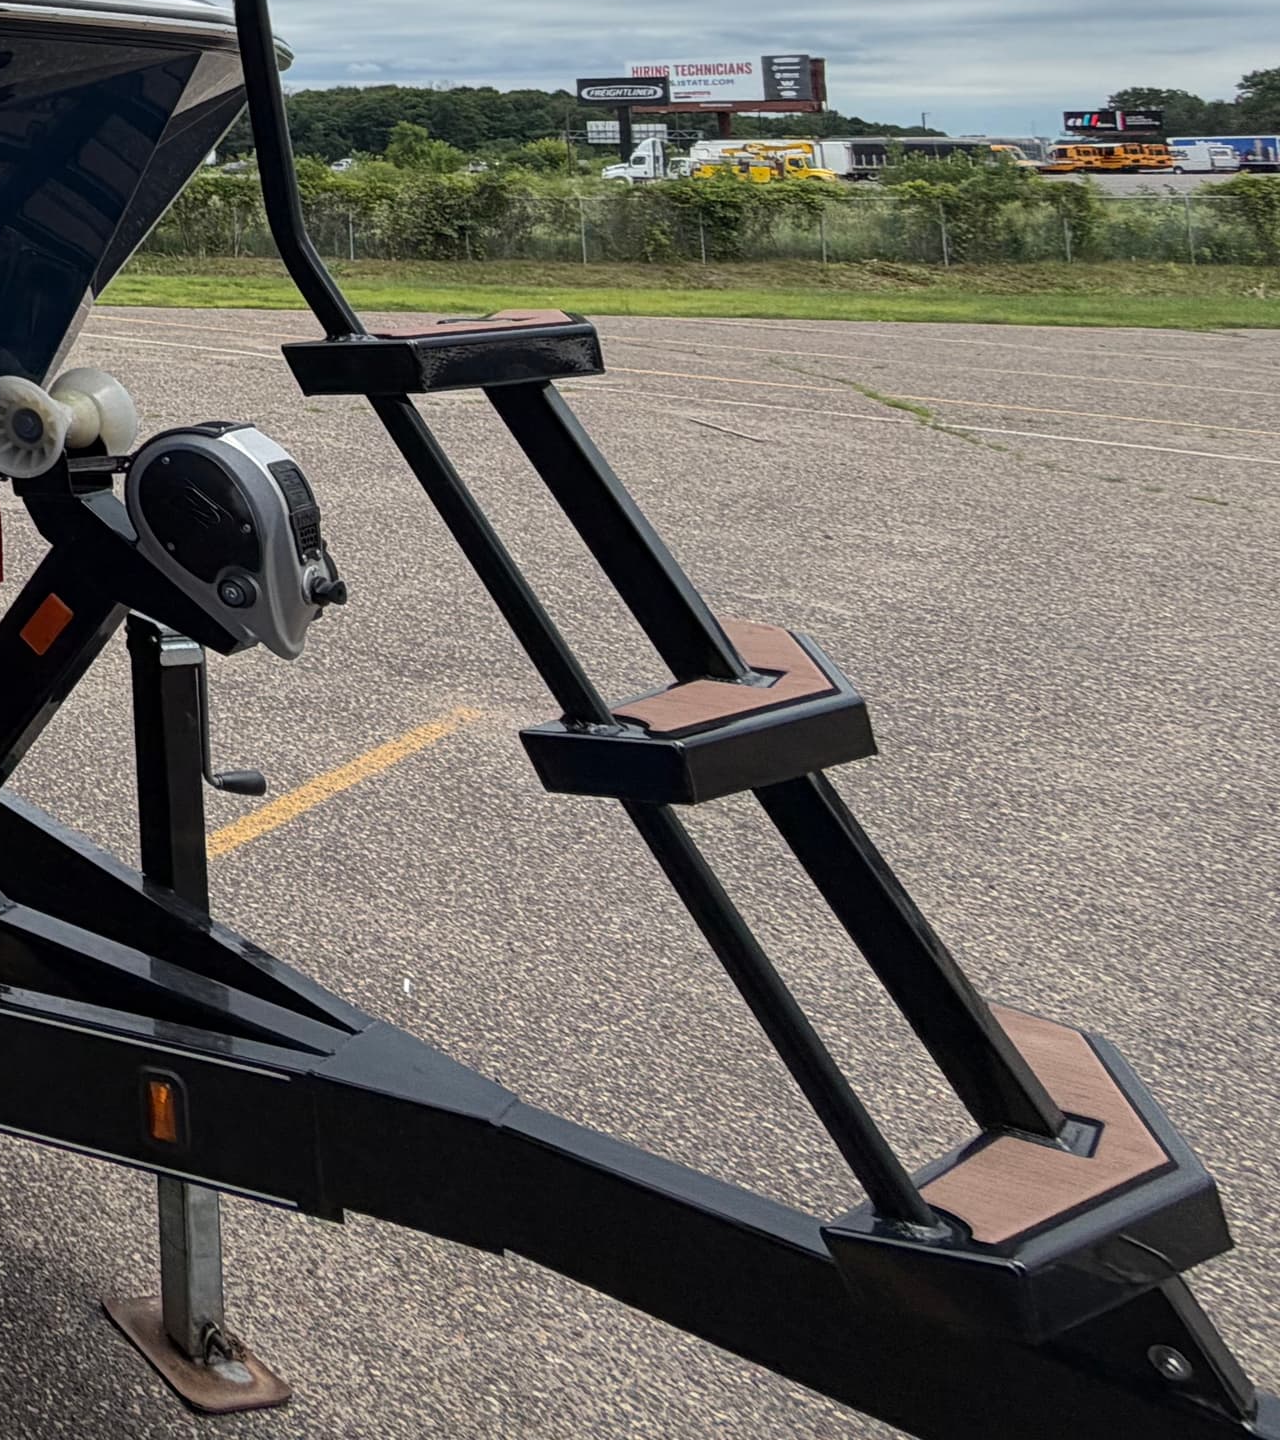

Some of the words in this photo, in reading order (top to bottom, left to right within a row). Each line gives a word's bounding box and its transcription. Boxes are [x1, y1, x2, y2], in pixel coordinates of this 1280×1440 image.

[631, 65, 670, 77] HIRING
[673, 62, 753, 77] TECHNICIANS
[589, 88, 655, 97] FREIGHTLINER
